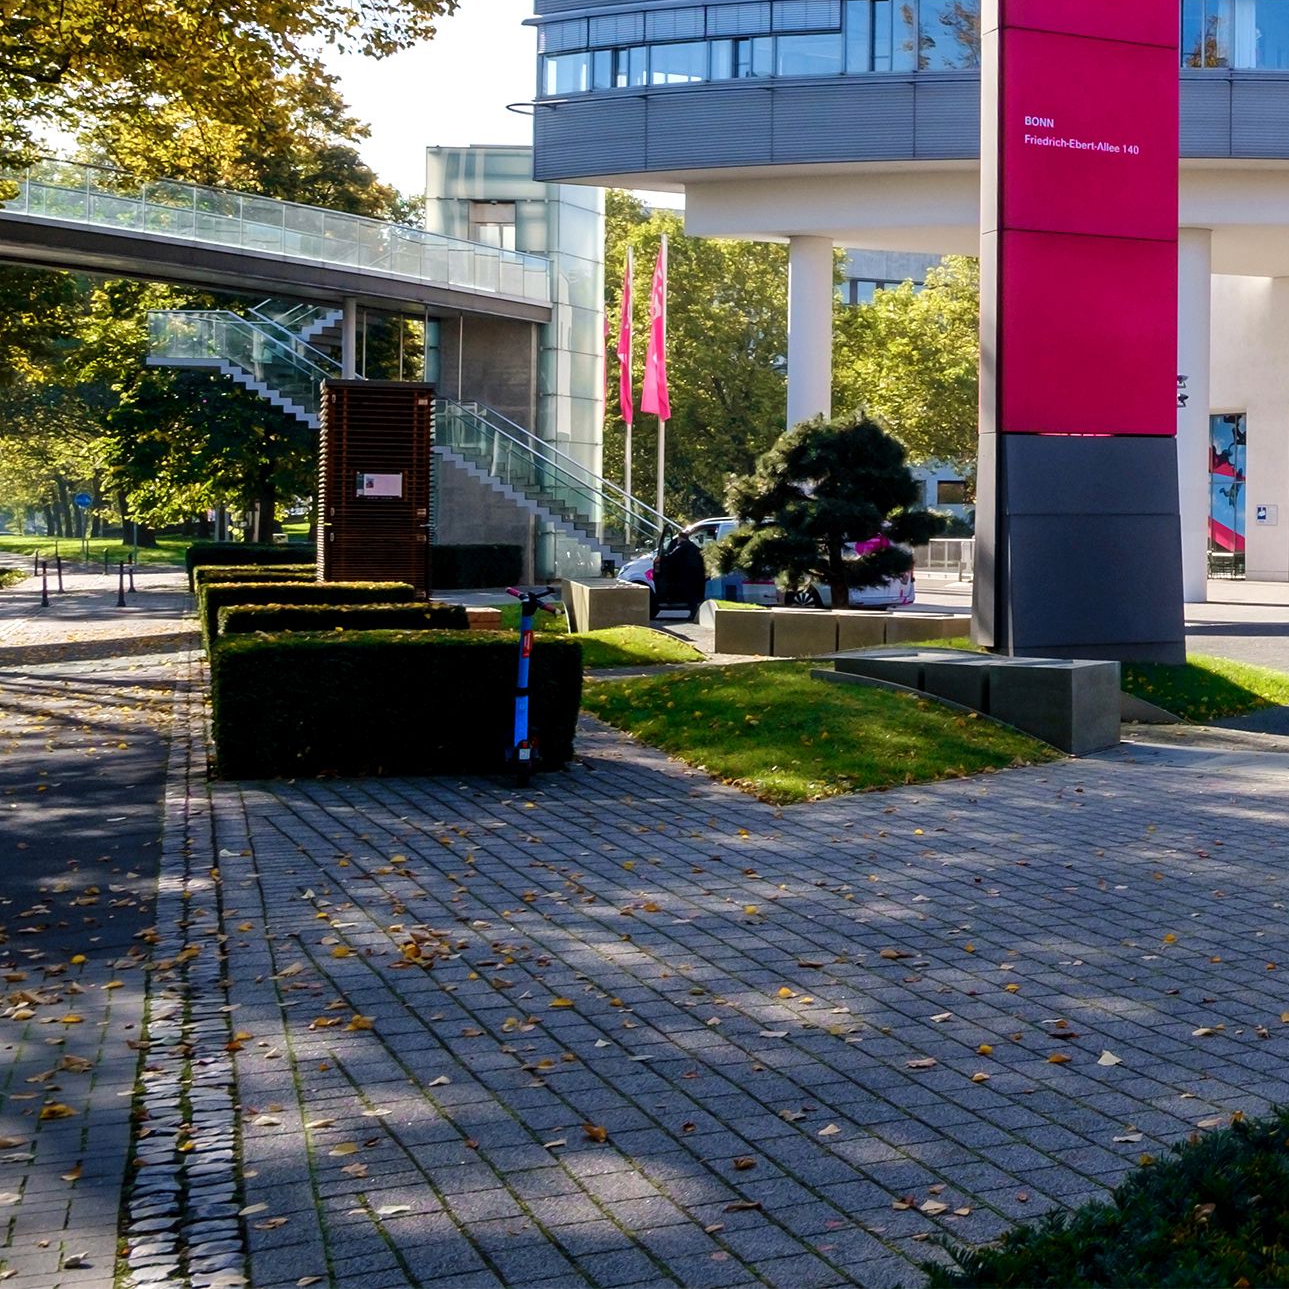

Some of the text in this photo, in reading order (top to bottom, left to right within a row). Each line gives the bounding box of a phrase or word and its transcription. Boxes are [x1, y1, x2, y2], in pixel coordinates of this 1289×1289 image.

[1024, 116, 1055, 128] BONN
[1024, 134, 1140, 155] Friedrich-Ebert-Allee 140
